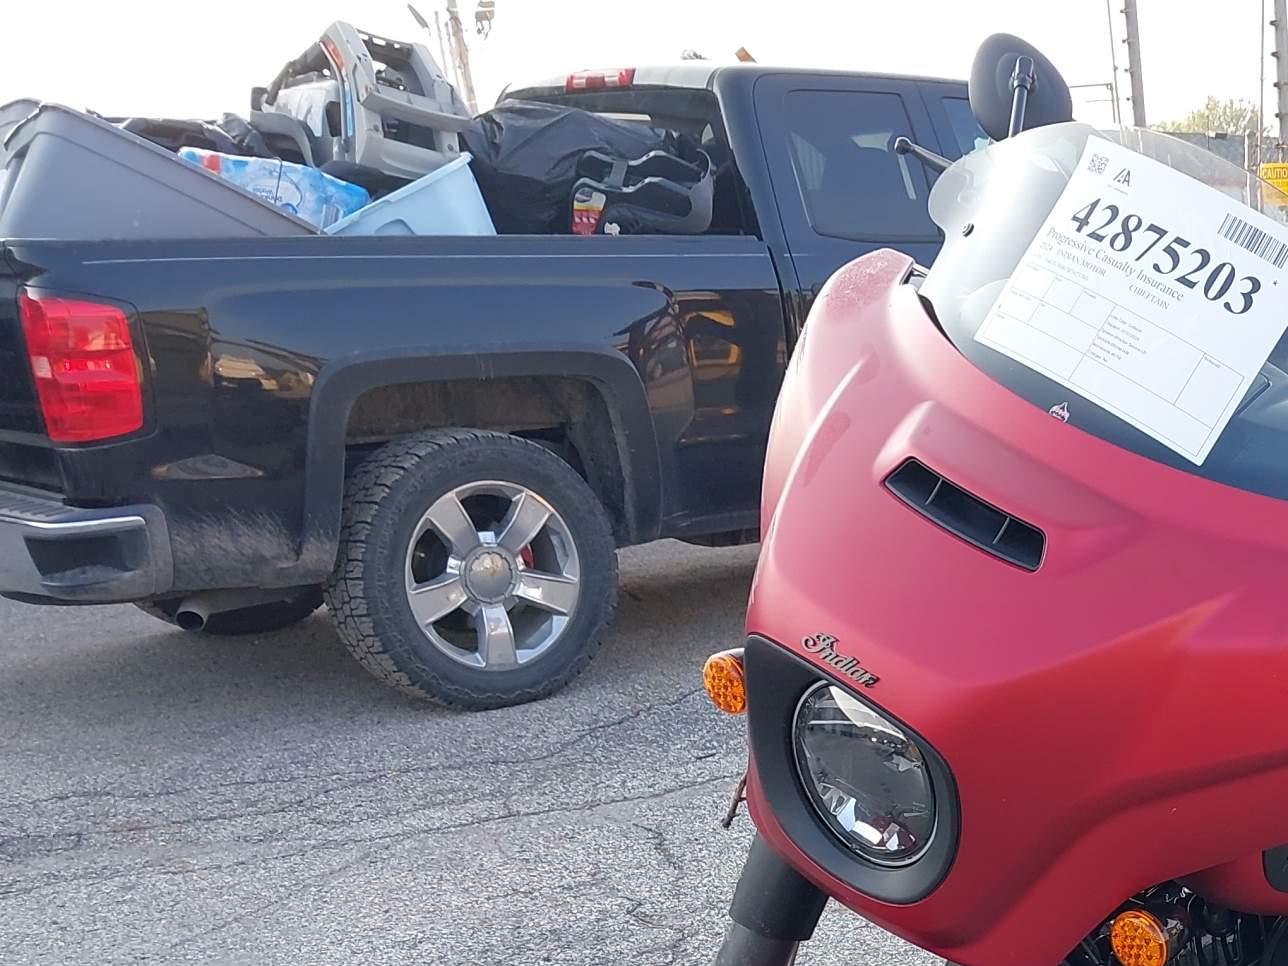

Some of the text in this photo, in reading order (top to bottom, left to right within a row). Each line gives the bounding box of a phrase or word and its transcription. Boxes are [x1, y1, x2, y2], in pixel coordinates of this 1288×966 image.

[1047, 226, 1095, 255] Progressive
[1095, 248, 1137, 277] Casualty
[1136, 268, 1184, 302] Insurance
[1071, 198, 1261, 314] 42875203
[1128, 284, 1170, 310] CHIEFTAIN
[802, 633, 880, 688] Indian
